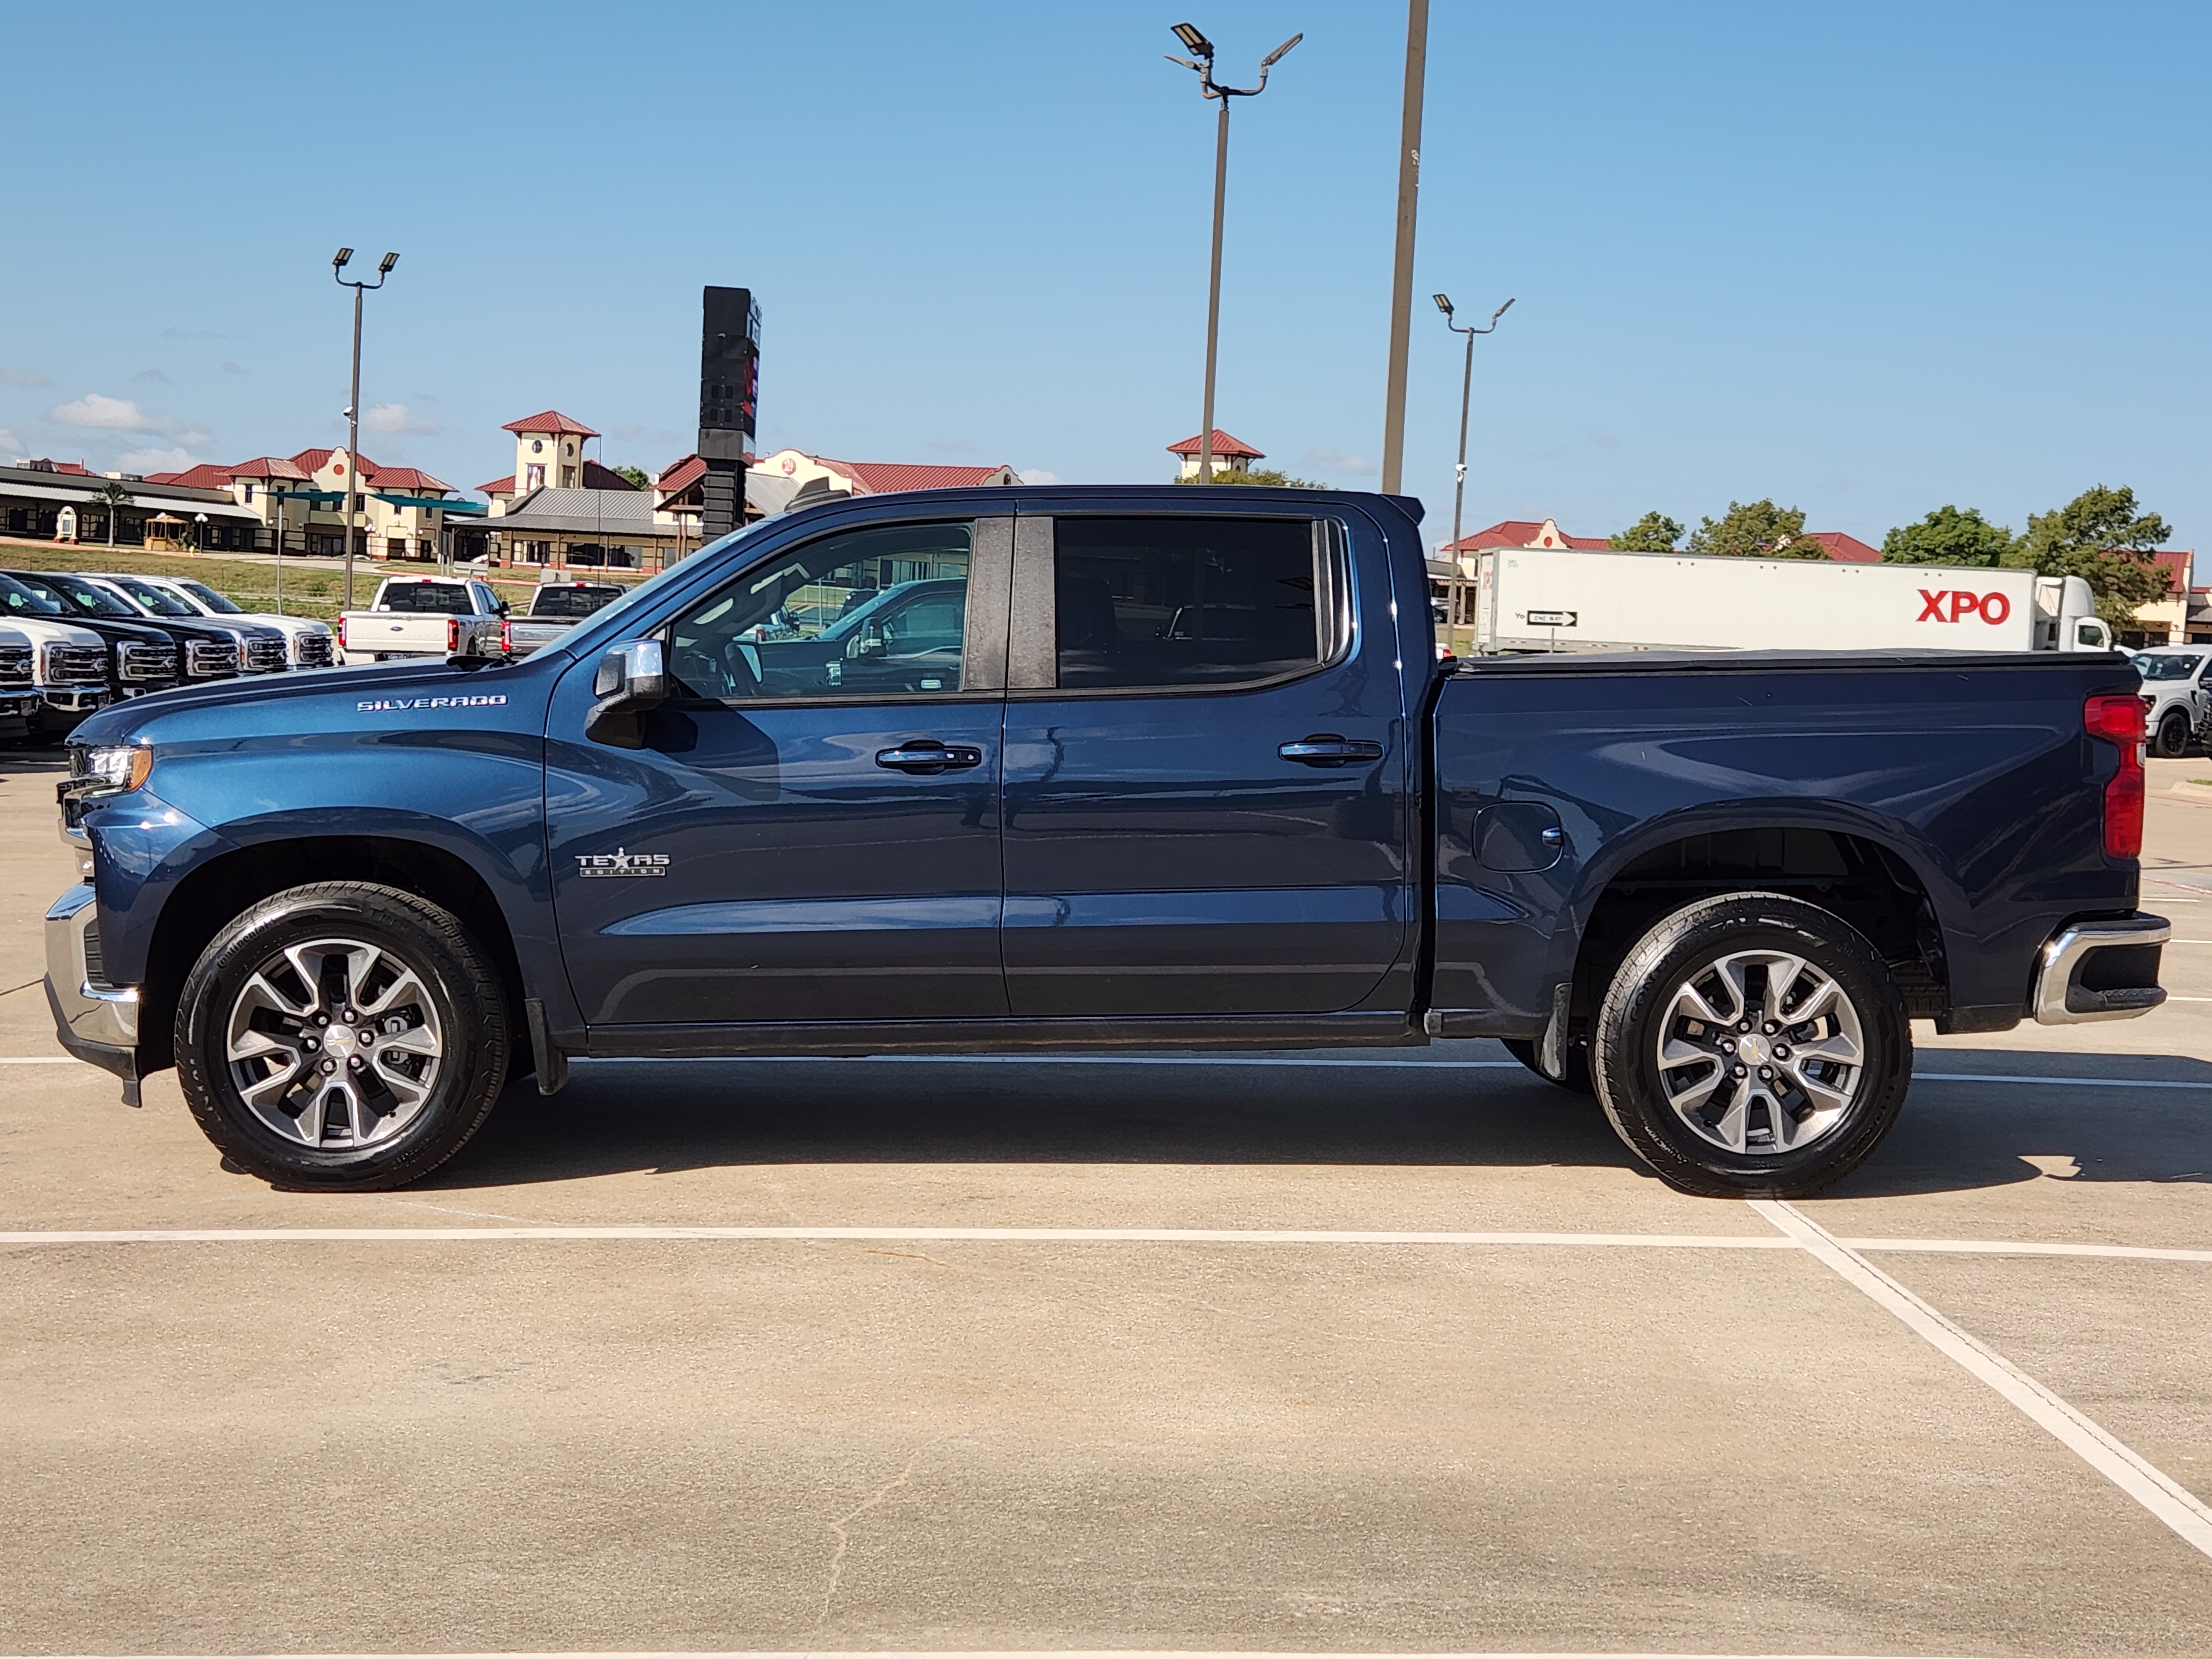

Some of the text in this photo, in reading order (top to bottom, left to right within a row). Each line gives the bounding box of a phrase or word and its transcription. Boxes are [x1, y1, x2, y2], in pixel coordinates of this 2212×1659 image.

[1915, 589, 2011, 625] XPO
[357, 695, 509, 712] SILVERADO
[575, 847, 671, 869] TEXAS
[216, 921, 270, 969] Continental
